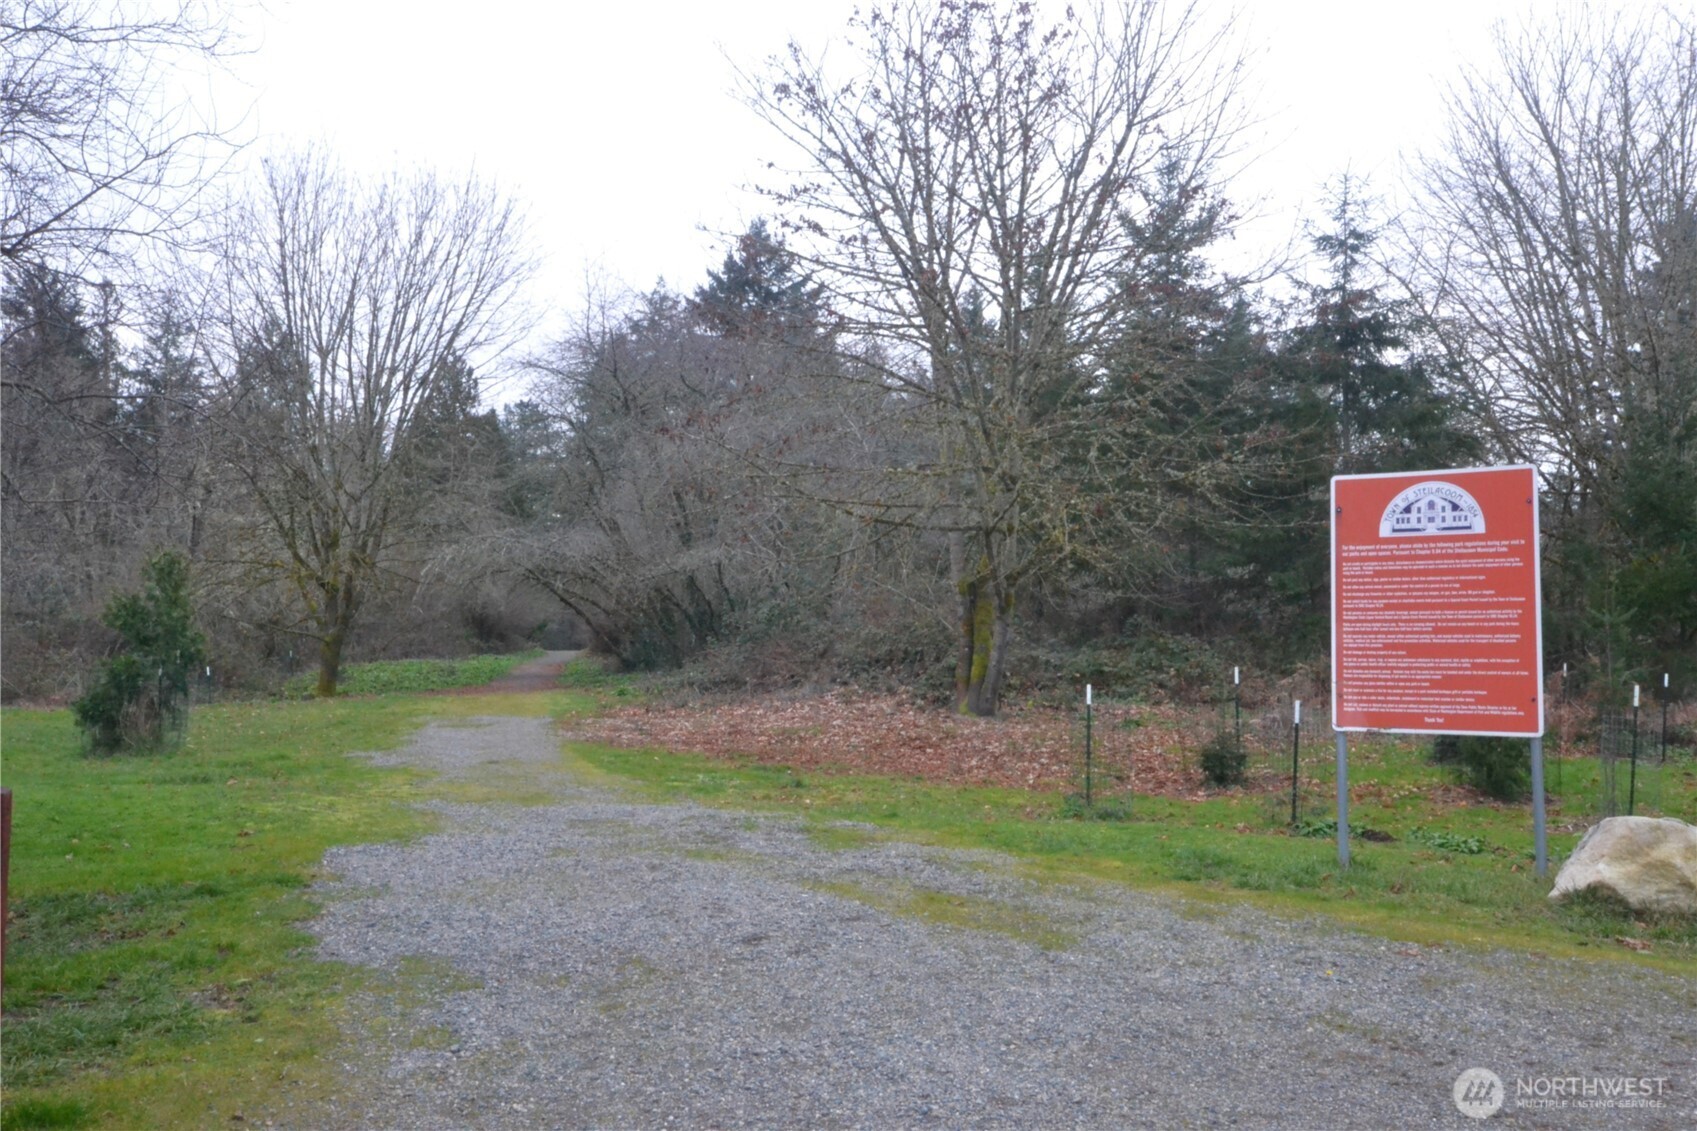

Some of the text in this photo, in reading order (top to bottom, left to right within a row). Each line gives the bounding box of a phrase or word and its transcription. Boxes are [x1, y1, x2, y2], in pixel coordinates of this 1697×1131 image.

[1385, 504, 1400, 522] TOWN
[1402, 494, 1410, 503] OF
[1413, 487, 1463, 502] STEILACOOM
